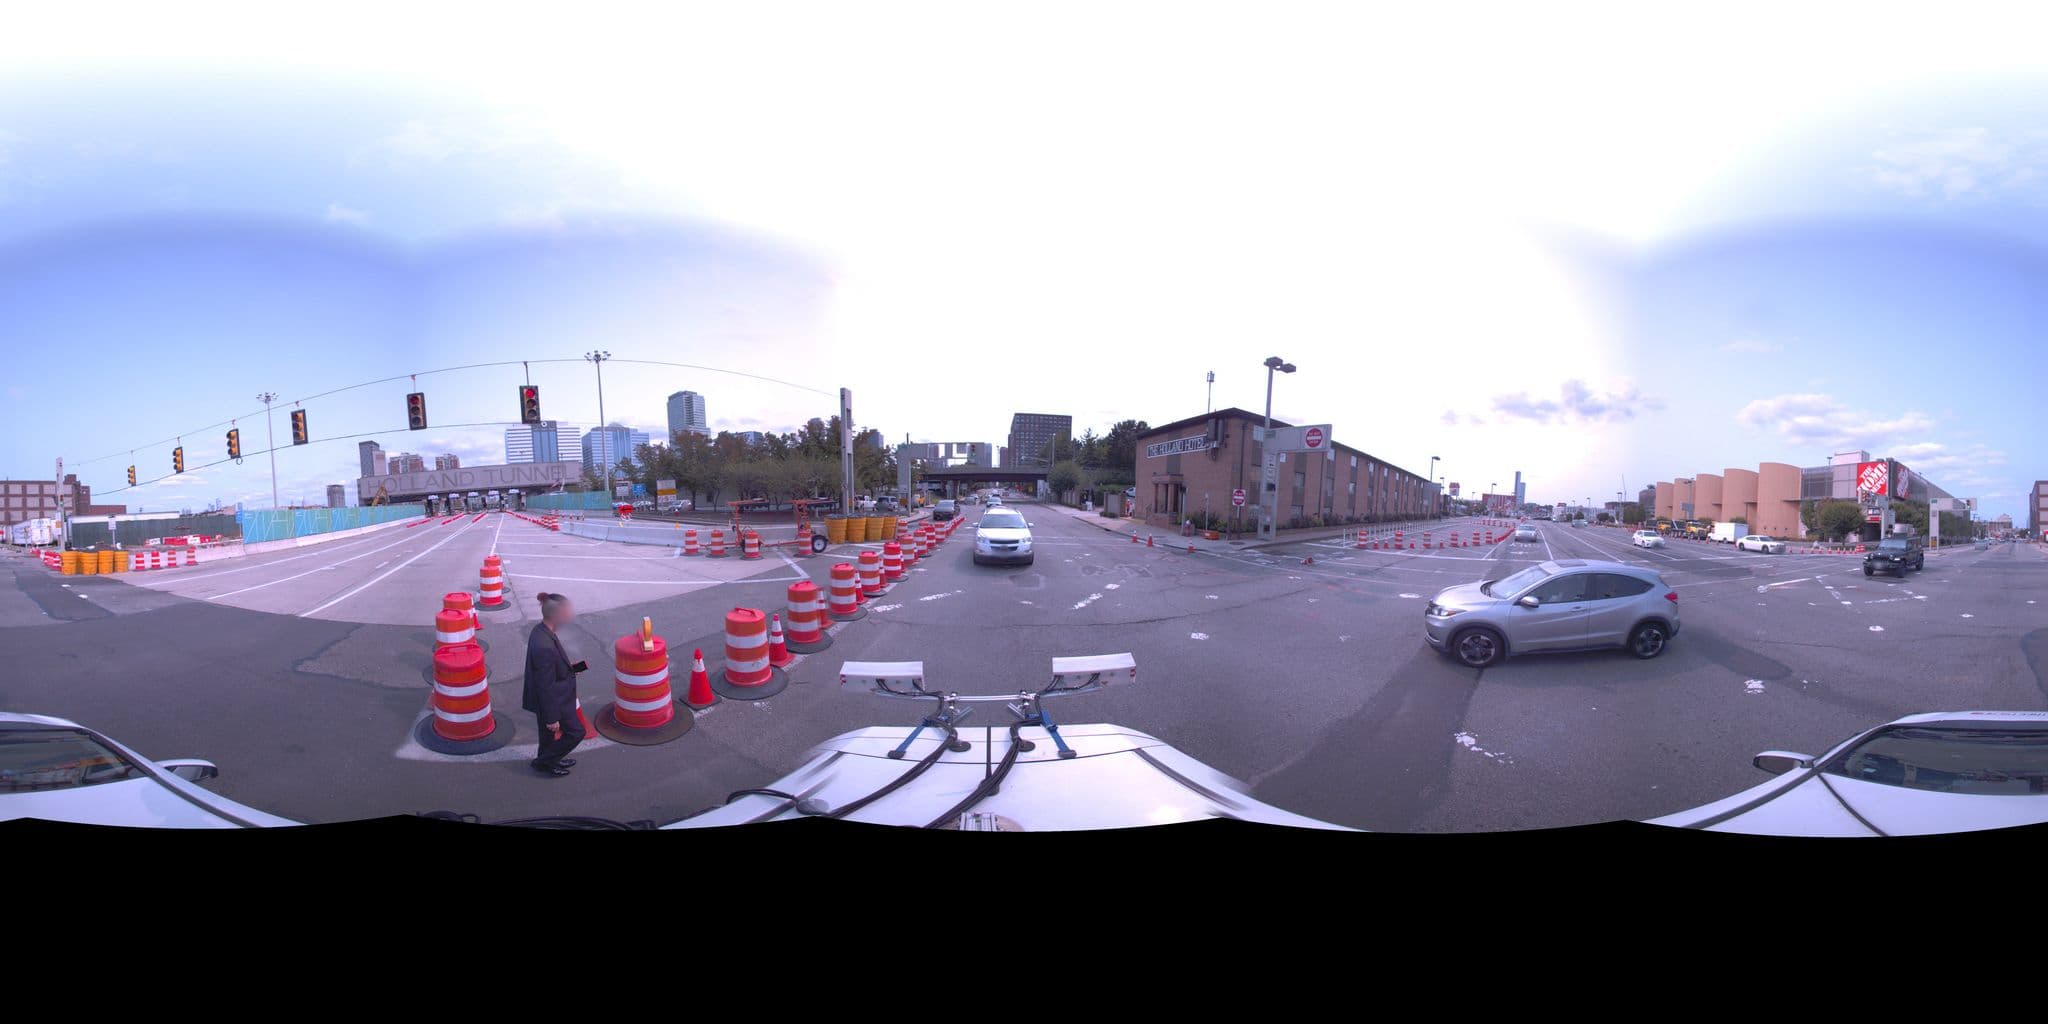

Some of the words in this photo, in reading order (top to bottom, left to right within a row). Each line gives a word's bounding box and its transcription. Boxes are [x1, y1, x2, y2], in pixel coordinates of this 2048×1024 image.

[1159, 440, 1184, 454] HOLLAND
[1184, 437, 1206, 451] HOTEL
[367, 471, 475, 494] HOLLAND
[482, 464, 575, 484] TUNNEL
[1860, 466, 1873, 479] THE
